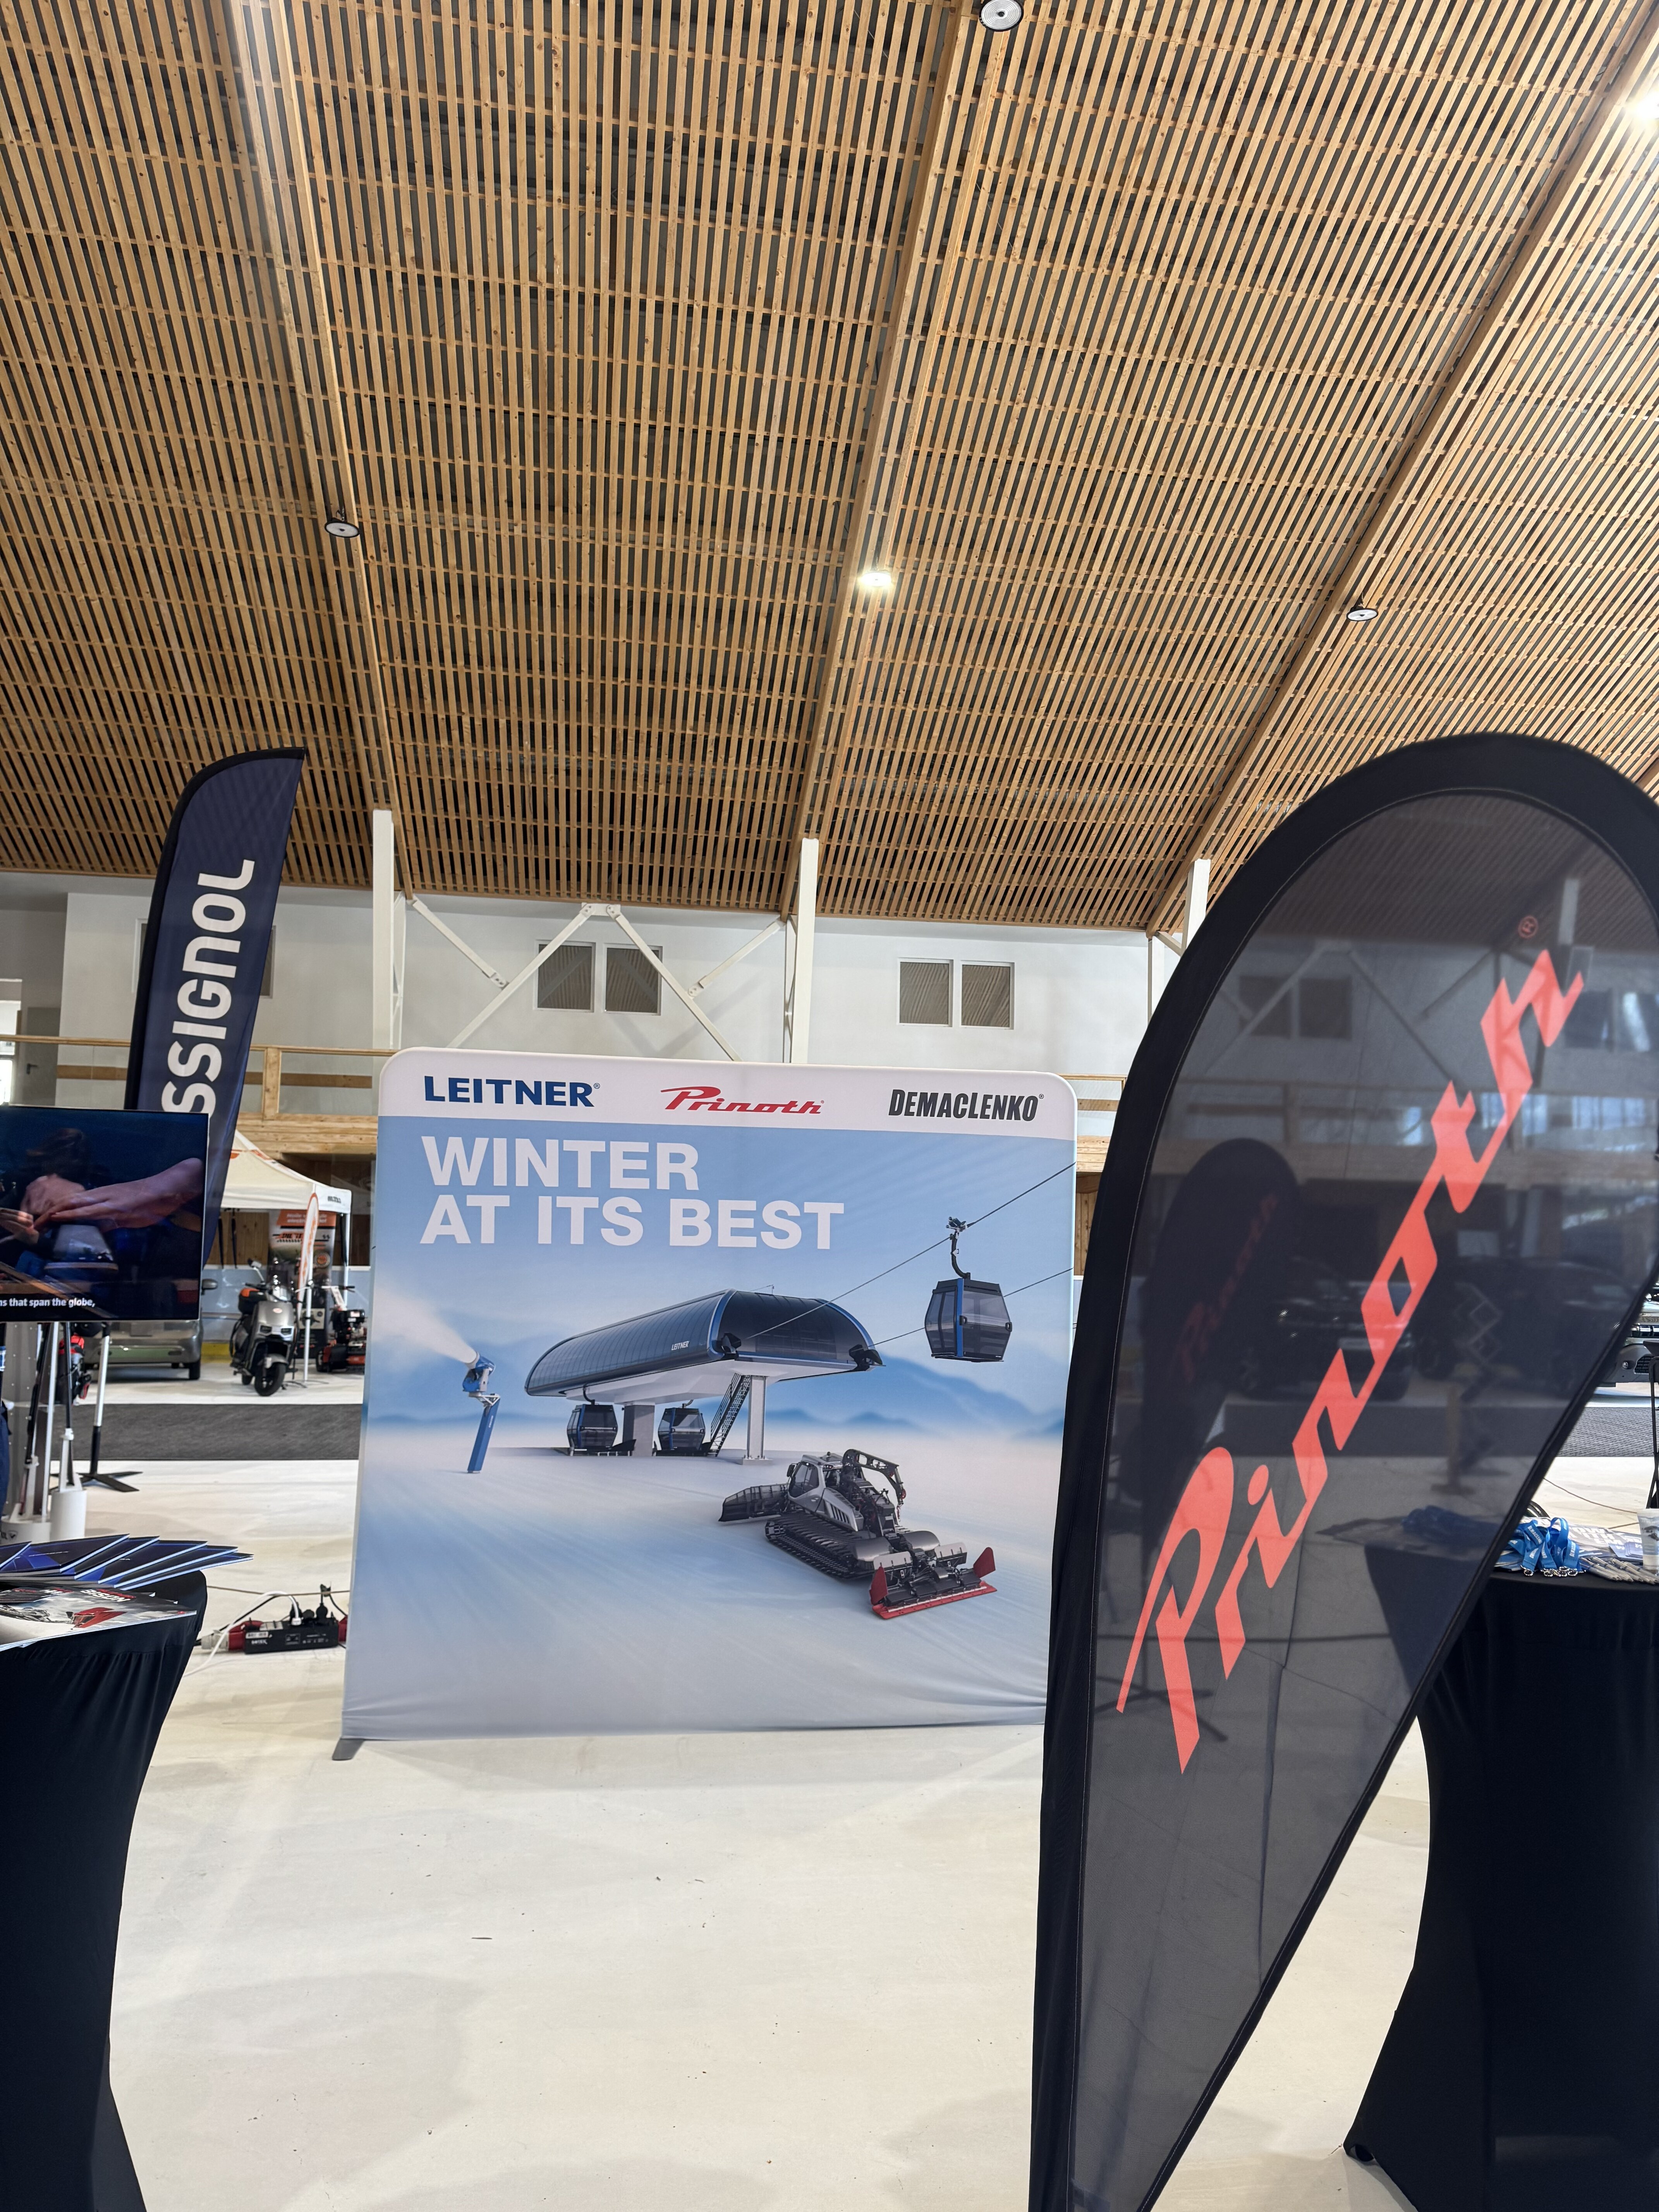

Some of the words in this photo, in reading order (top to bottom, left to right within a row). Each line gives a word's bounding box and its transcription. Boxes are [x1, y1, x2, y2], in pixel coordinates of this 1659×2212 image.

[421, 1136, 699, 1190] WINTER
[420, 1195, 510, 1244] AT
[538, 1195, 644, 1246] ITS
[669, 1198, 844, 1250] BEST
[9, 1298, 27, 1307] that
[29, 1299, 50, 1308] span
[52, 1298, 66, 1307] the
[68, 1298, 96, 1308] globe,
[671, 1341, 690, 1351] LEITNER
[80, 1589, 131, 1602] BISON
